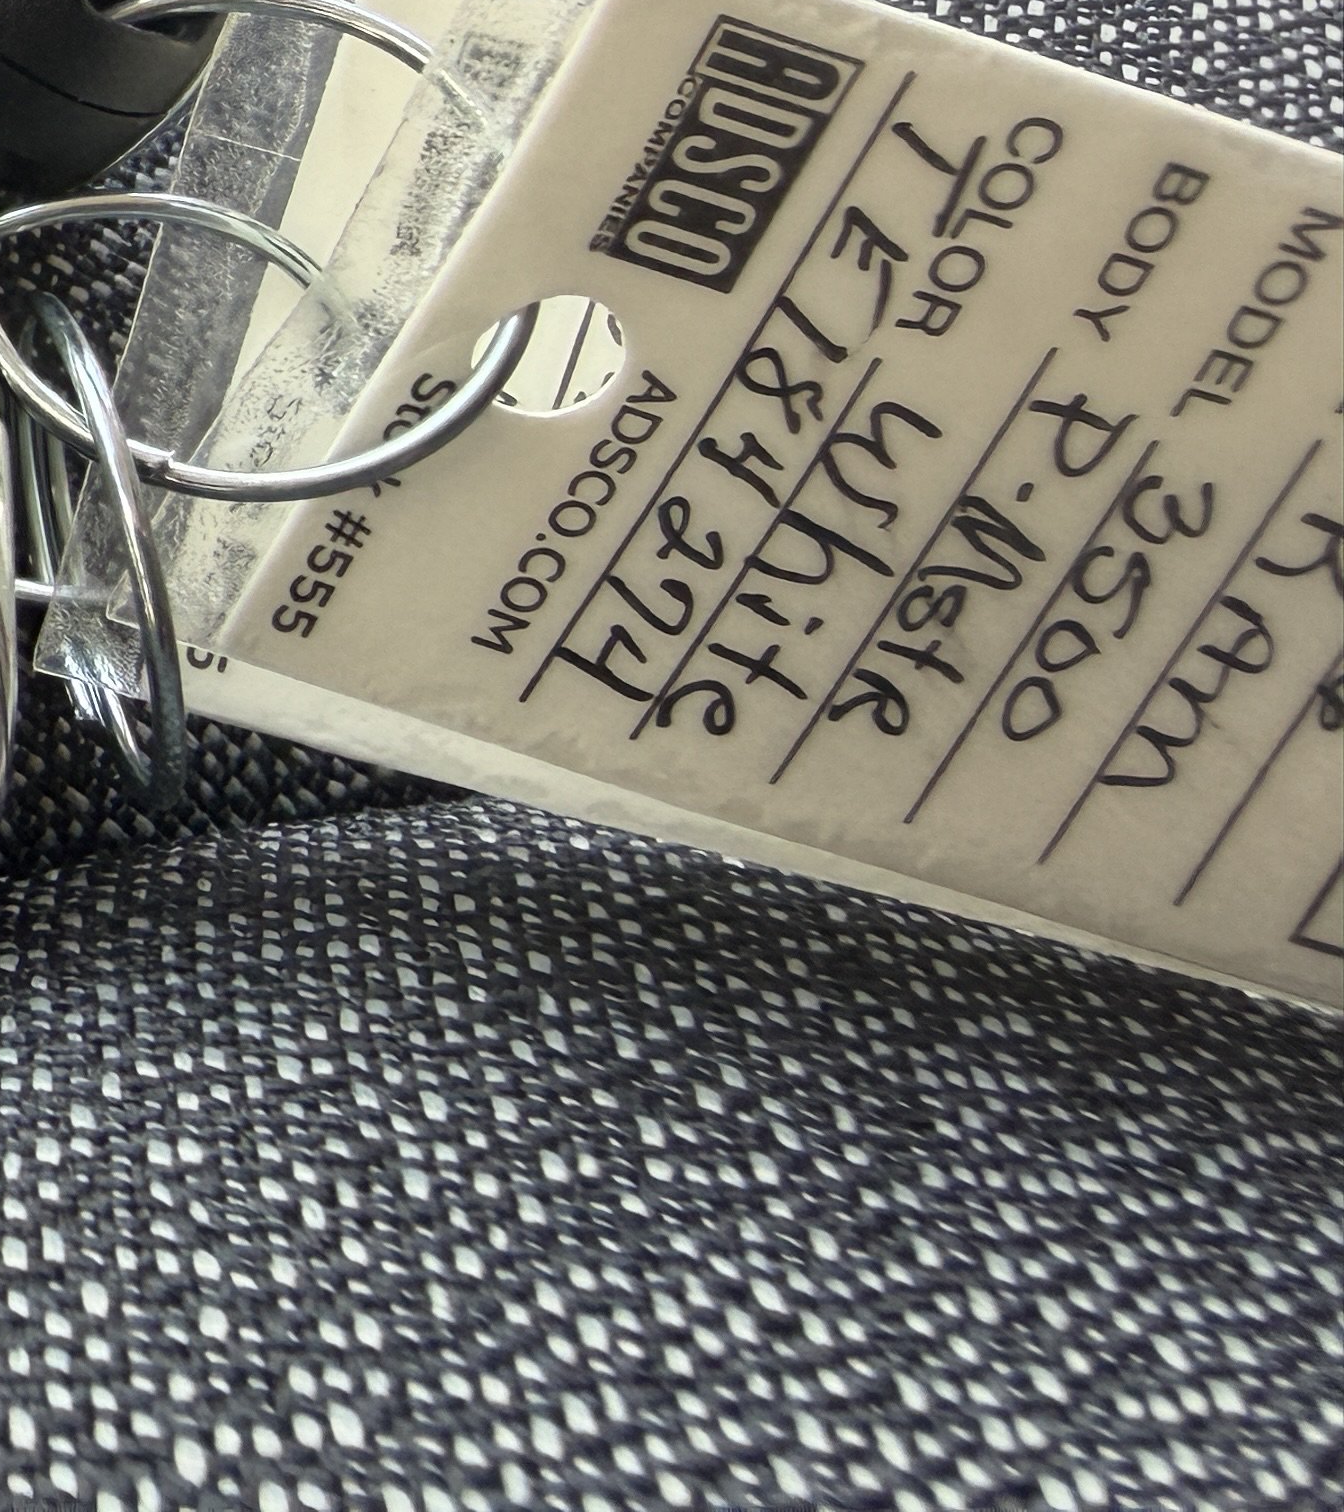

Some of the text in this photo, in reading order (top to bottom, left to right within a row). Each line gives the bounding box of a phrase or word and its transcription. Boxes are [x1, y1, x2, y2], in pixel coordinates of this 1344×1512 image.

[588, 76, 698, 252] COMPANIES
[623, 25, 841, 278] ADSCO
[895, 116, 1063, 337] COLOR
[1072, 161, 1210, 343] BODY
[1169, 206, 1344, 418] MODEL
[271, 508, 372, 639] #555
[470, 369, 678, 655] ADSCO.COM
[656, 400, 943, 737] White
[1002, 482, 1214, 742] 3500
